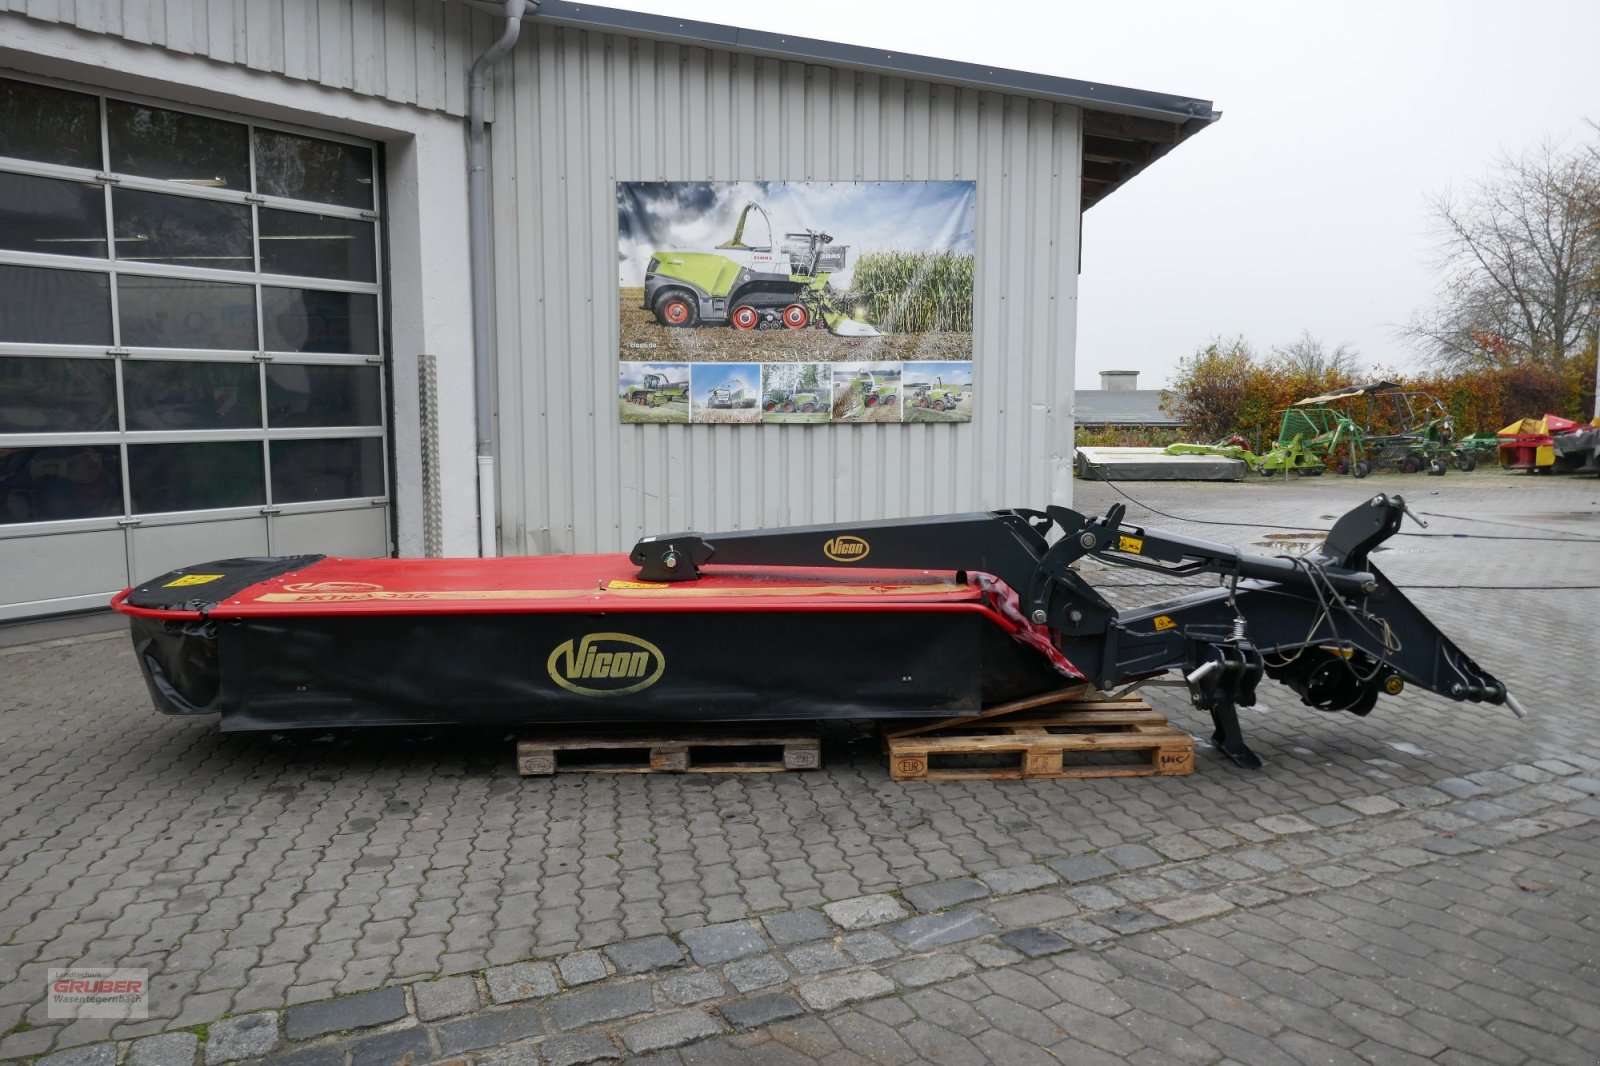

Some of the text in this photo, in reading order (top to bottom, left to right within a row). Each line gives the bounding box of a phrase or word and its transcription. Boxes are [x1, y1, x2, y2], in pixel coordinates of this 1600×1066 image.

[829, 536, 864, 555] Vicon
[294, 593, 373, 602] EXTRA
[563, 634, 652, 681] Vicon
[903, 761, 919, 772] EUR
